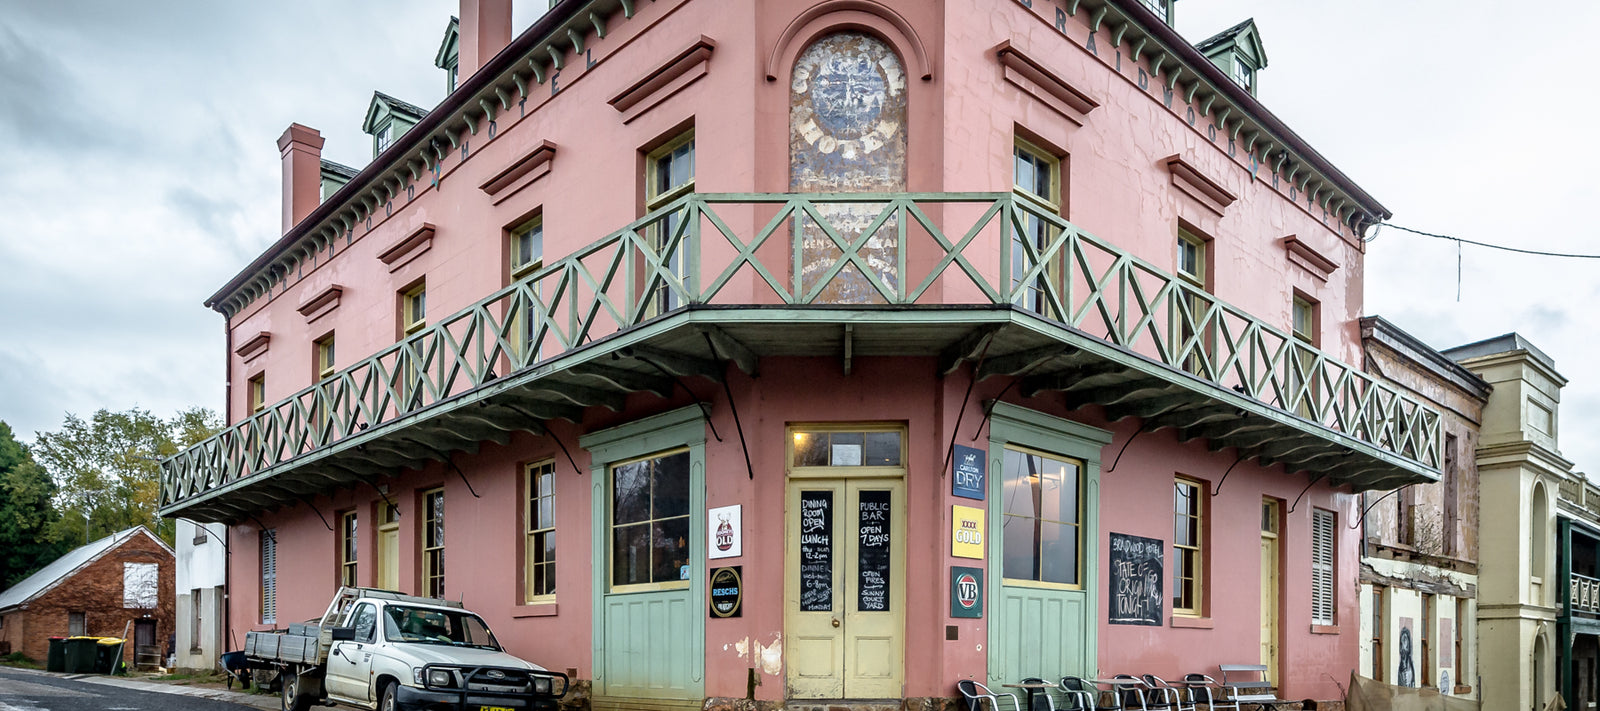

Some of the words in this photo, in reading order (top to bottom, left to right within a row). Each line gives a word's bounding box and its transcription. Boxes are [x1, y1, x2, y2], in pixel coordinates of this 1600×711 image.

[460, 47, 597, 161] HOTEL
[1271, 174, 1344, 236] HOTEL
[959, 464, 979, 474] CARLTON
[956, 471, 983, 489] DRY
[860, 502, 889, 511] PUBLIC
[803, 508, 825, 518] ROOM
[862, 511, 885, 520] BAR
[803, 519, 825, 527] OPEN
[961, 520, 977, 529] XXXX
[861, 526, 882, 534] OPEN
[717, 536, 733, 547] OLD
[801, 534, 829, 545] LUNCH
[860, 535, 867, 544] 7
[869, 534, 889, 543] DAYS
[955, 529, 982, 544] GOLD
[1113, 559, 1138, 579] STATE
[1137, 562, 1149, 577] OF
[712, 587, 739, 597] RESCHS
[861, 589, 885, 597] SUNNY
[959, 583, 977, 600] VB
[864, 602, 884, 610] YARD
[1116, 593, 1149, 619] TONIGHT
